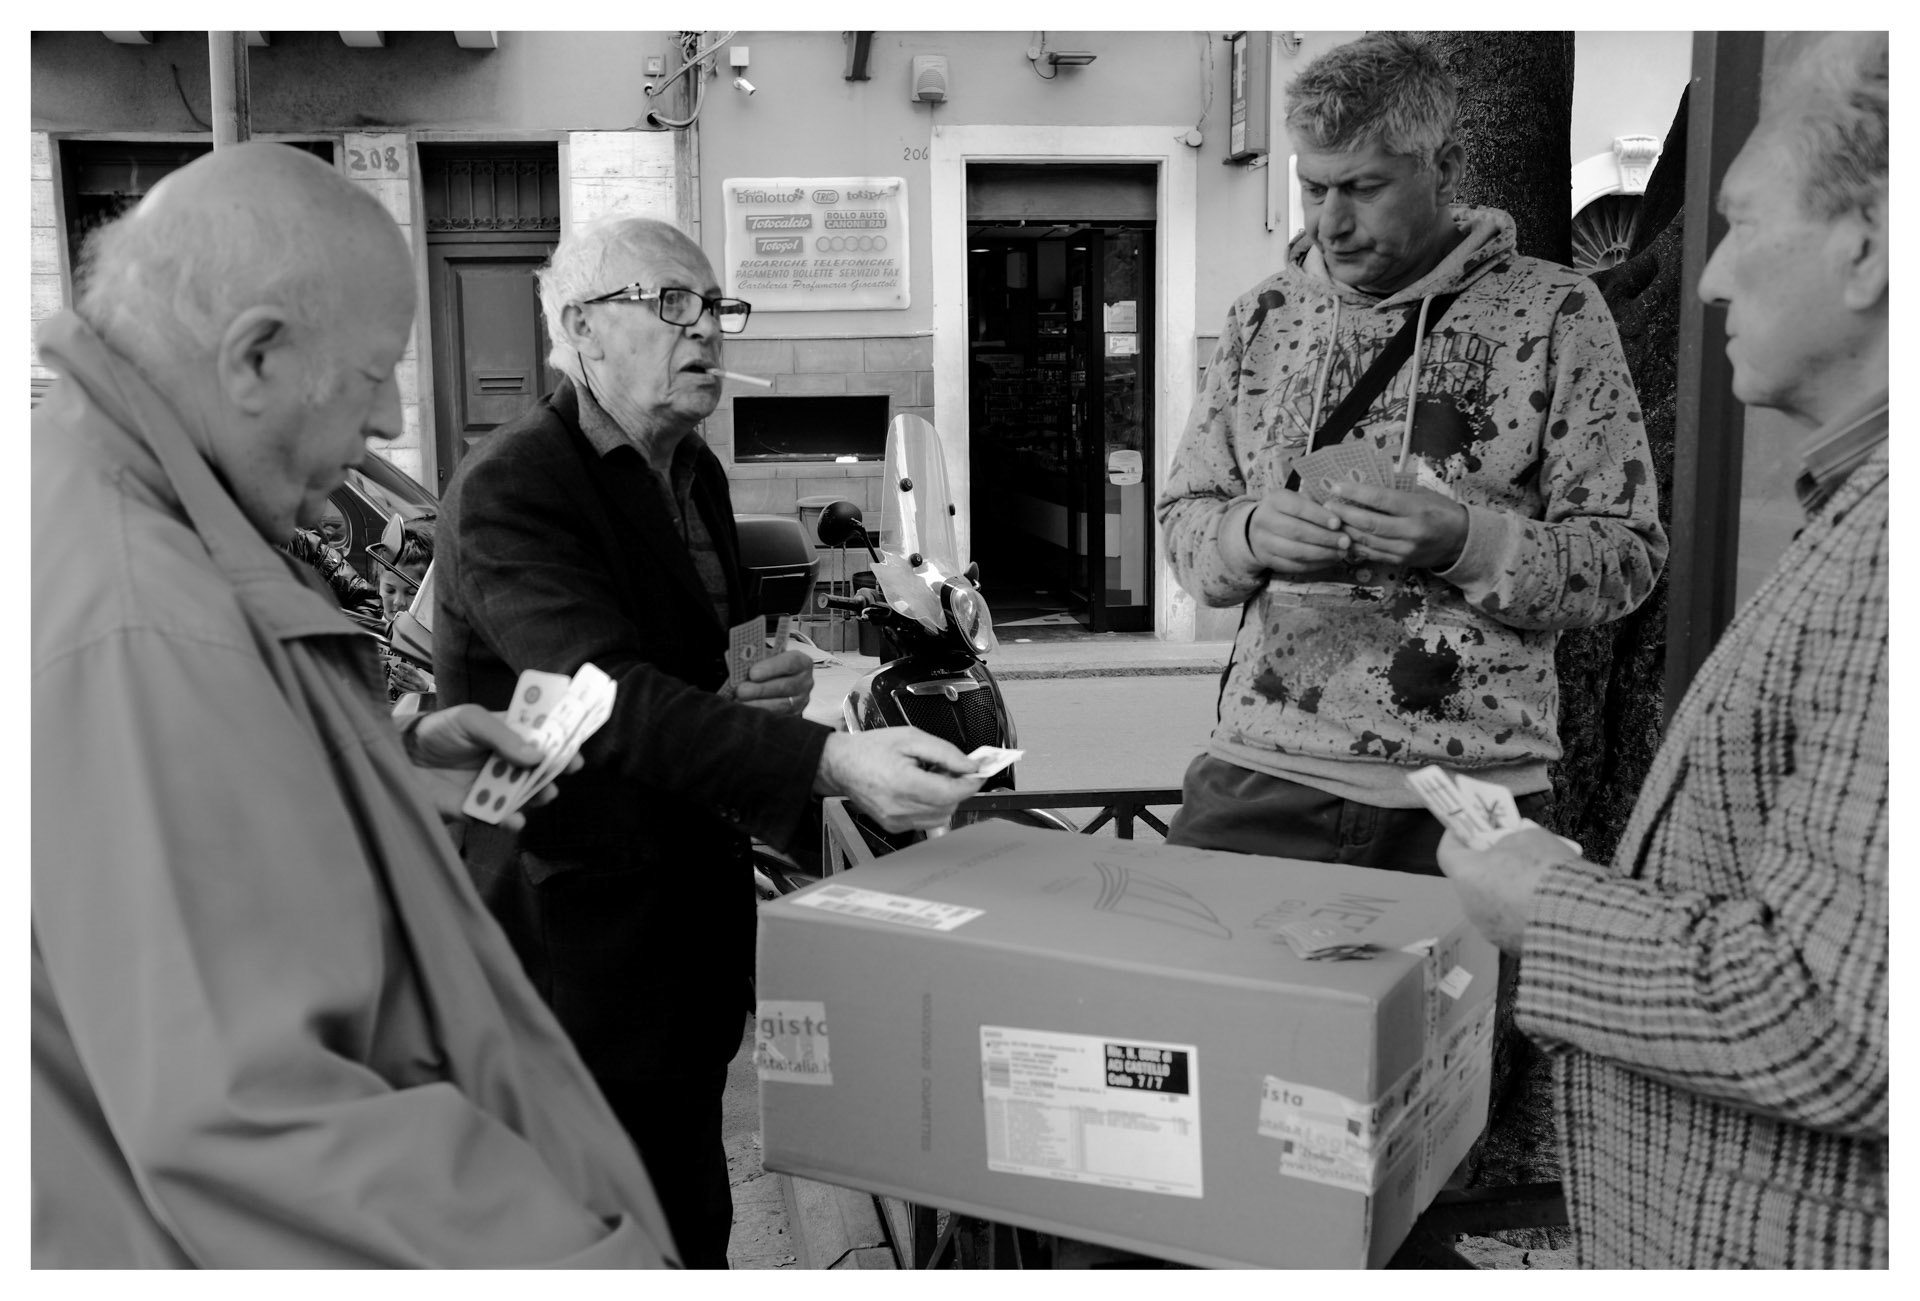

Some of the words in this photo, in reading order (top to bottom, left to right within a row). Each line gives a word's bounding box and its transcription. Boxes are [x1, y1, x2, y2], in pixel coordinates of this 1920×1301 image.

[349, 146, 400, 173] 208
[903, 146, 929, 161] 206
[736, 190, 795, 204] Enalotto
[826, 212, 849, 220] BOLLO
[859, 211, 886, 219] AUTO
[748, 216, 811, 230] Totocalcio
[826, 220, 866, 229] CANONE
[868, 220, 886, 229] RAI
[757, 238, 799, 254] Totogol
[740, 259, 808, 268] RICARICHE
[813, 258, 895, 267] TELEFONICHE
[735, 269, 790, 279] PAGAMENTO
[792, 269, 833, 279] BOLLETTE
[839, 268, 880, 278] SERVIZIO
[883, 267, 900, 278] FAX
[1124, 1059, 1171, 1078] CASTELLO
